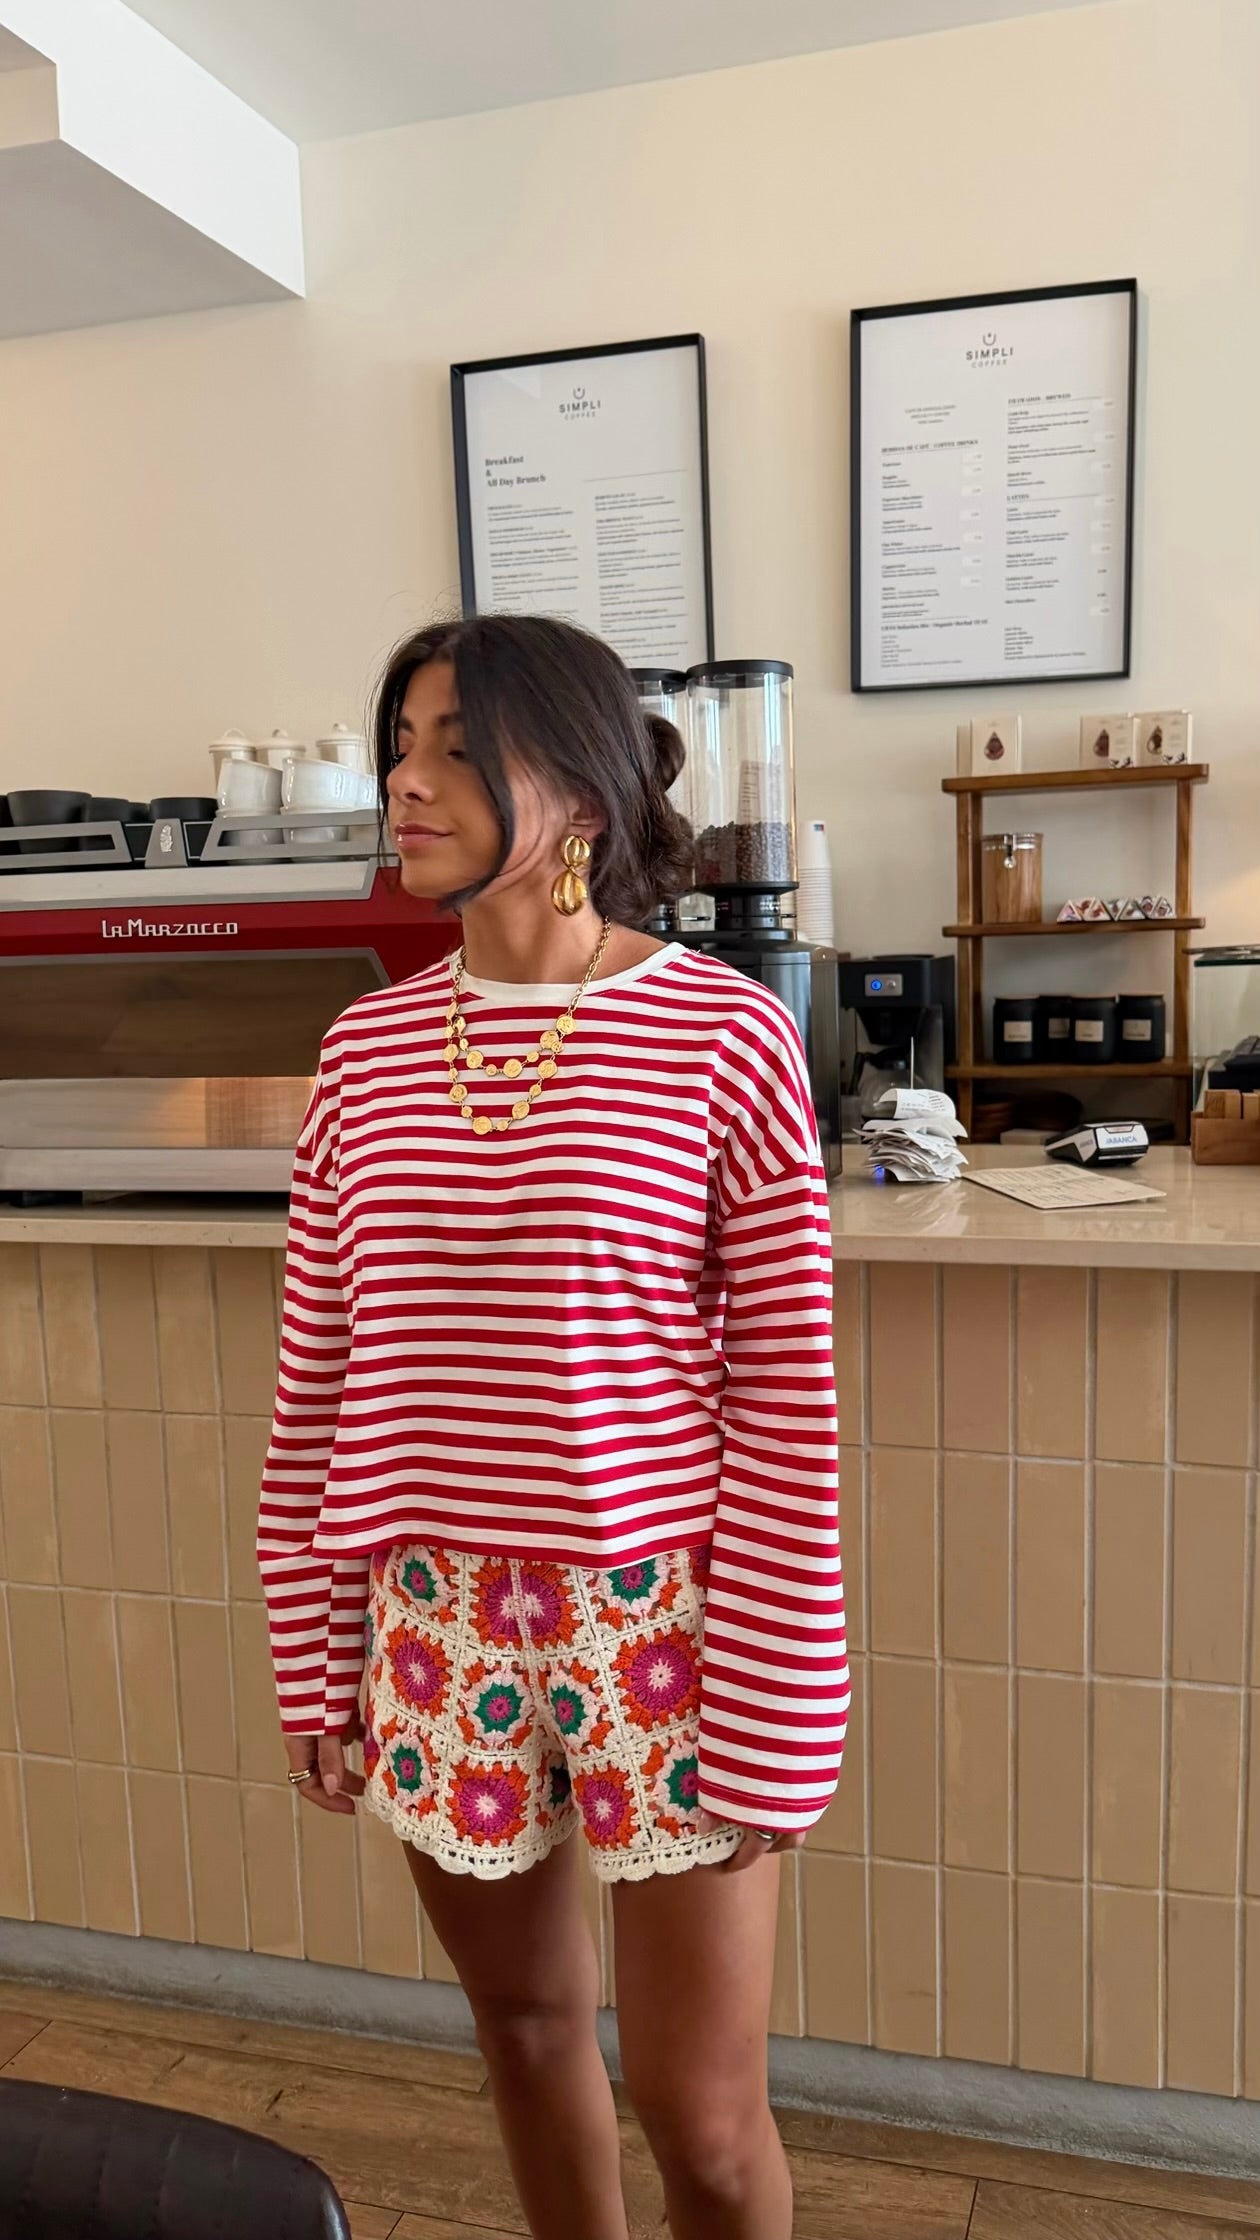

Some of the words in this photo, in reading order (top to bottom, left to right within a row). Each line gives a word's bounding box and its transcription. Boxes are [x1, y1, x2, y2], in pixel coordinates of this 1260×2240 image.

[966, 347, 1013, 361] SIMPLI
[559, 400, 601, 413] SIMPLI
[485, 456, 524, 466] Breakfast
[499, 478, 514, 488] Day
[516, 475, 546, 485] Brunch
[1107, 1136, 1137, 1145] ABANCA
